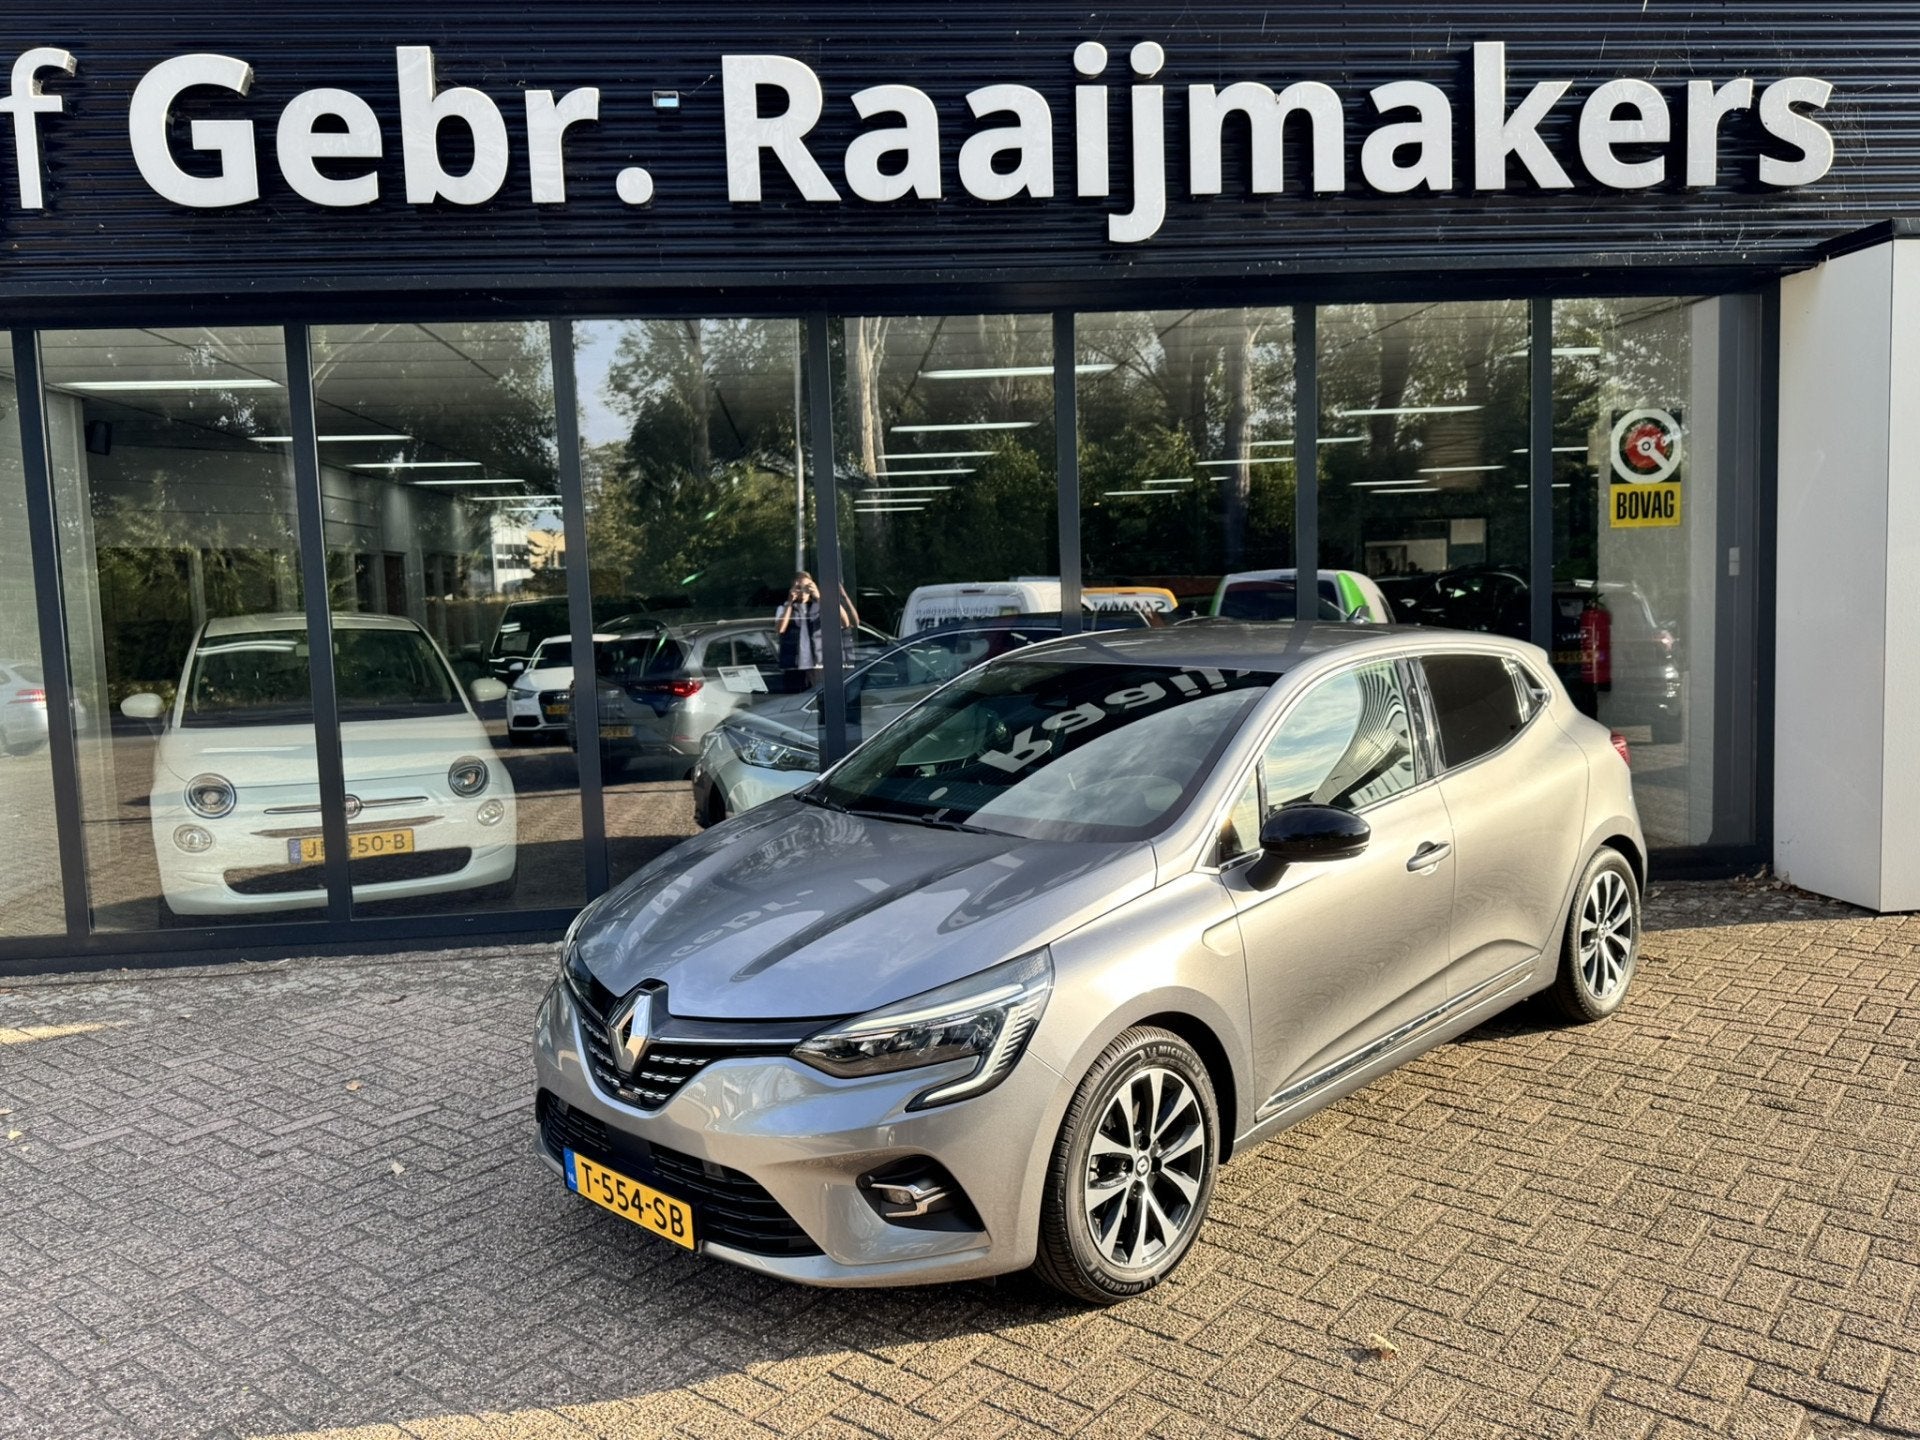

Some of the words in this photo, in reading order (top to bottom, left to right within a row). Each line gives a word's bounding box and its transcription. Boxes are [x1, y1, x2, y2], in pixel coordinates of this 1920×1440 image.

[129, 45, 654, 208] Gebr.
[721, 40, 1836, 243] Raaijmakers
[1616, 489, 1675, 520] BOVAG
[1158, 1045, 1201, 1074] MICHELIN
[580, 1161, 685, 1239] T-554-SB
[1092, 1271, 1142, 1293] MICHELIN
